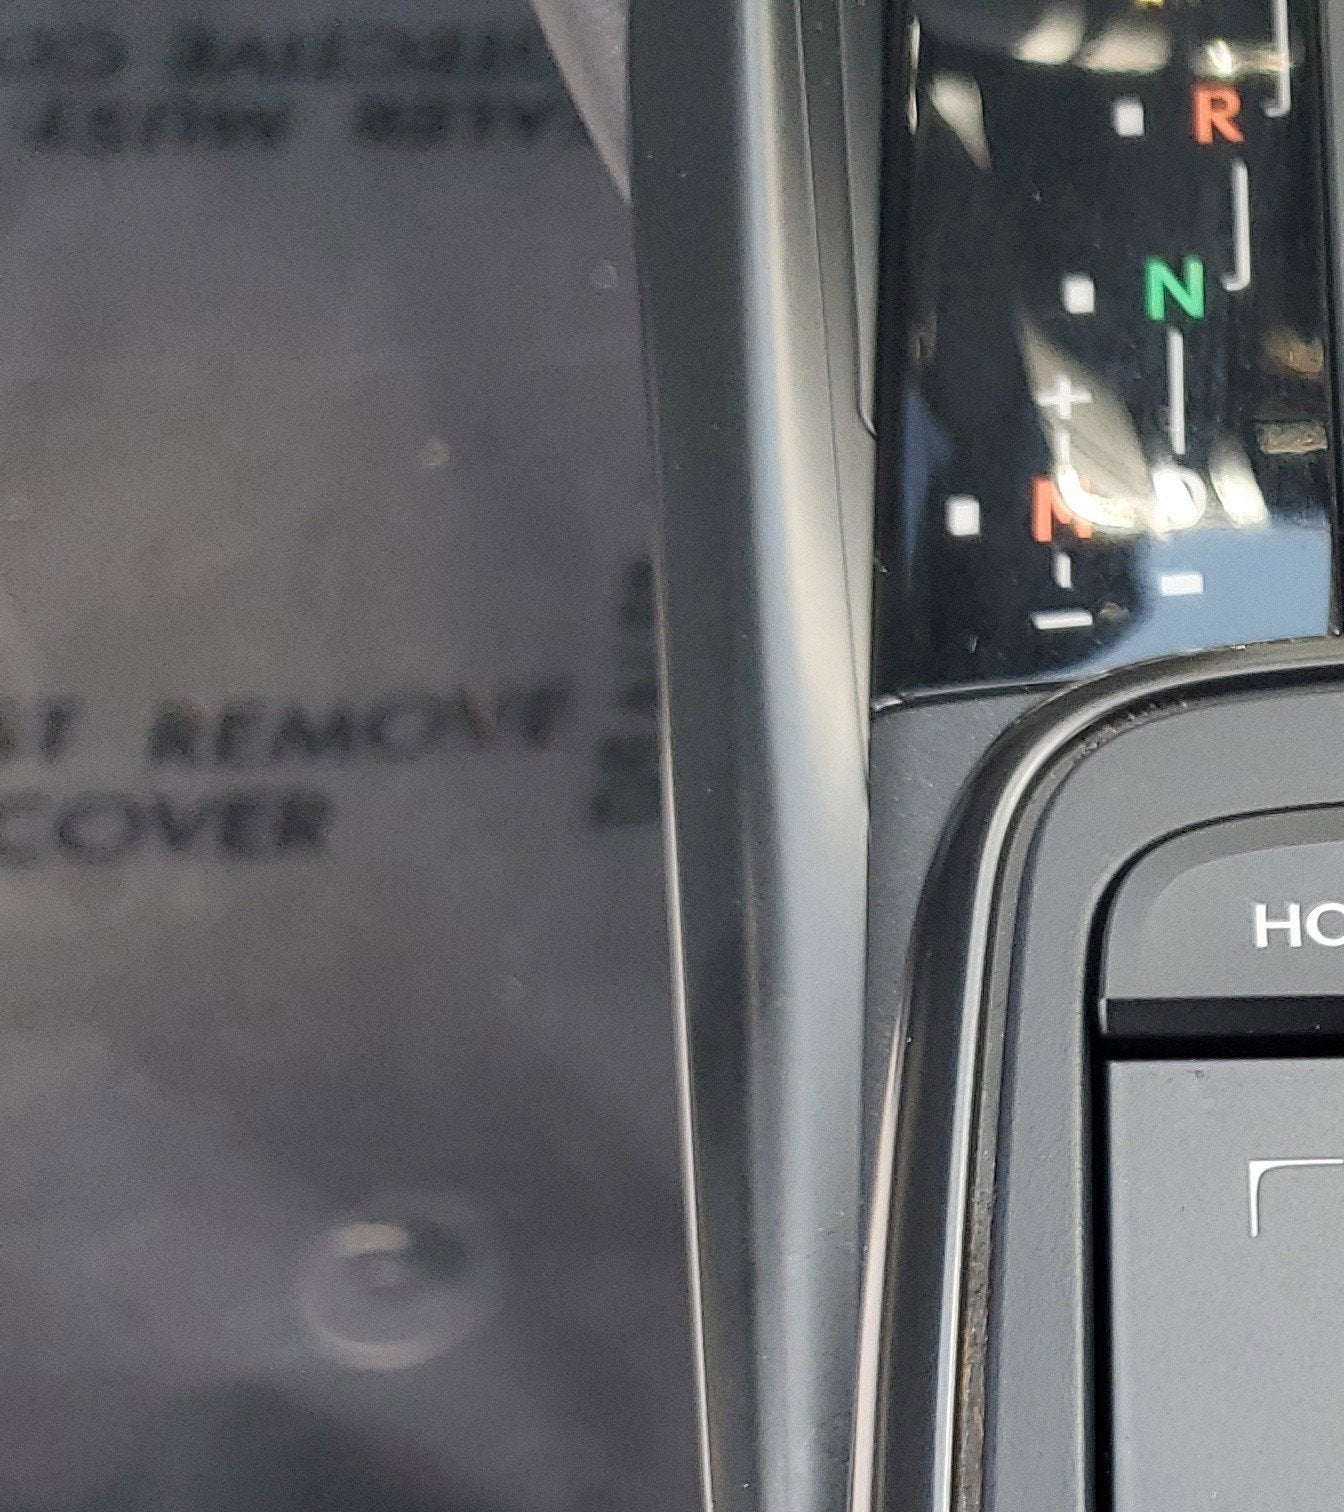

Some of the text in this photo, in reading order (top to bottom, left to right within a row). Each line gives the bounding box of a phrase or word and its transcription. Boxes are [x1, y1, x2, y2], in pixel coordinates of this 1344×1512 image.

[1193, 84, 1244, 145] R
[1145, 257, 1205, 320] N
[147, 674, 574, 767] REMOVE
